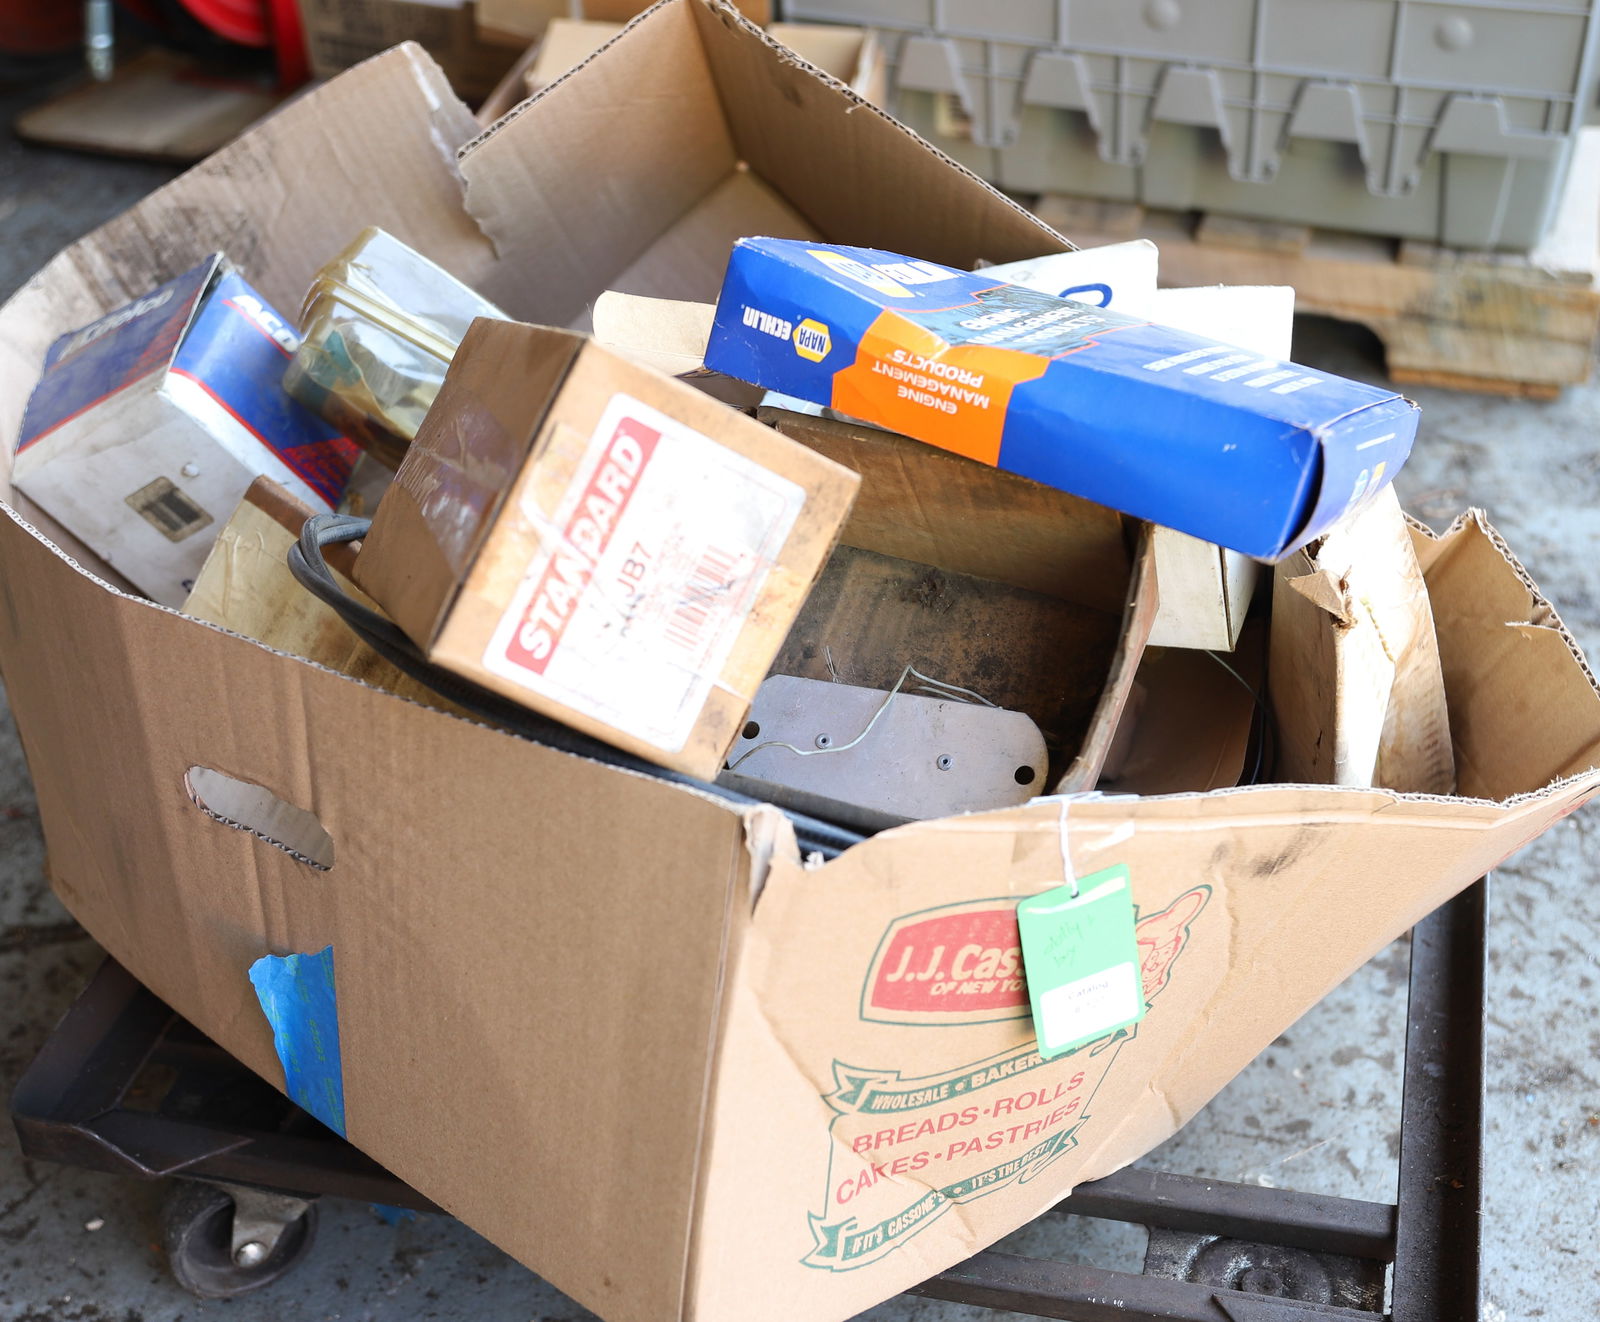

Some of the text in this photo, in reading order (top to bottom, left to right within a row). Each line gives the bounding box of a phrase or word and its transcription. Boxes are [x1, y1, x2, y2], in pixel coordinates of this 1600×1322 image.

[743, 306, 827, 353] NAPA ECHLIN
[871, 361, 990, 409] MANAGEMENT
[893, 349, 984, 388] PRODUCTS
[897, 385, 958, 414] ENGINE
[519, 434, 643, 660] STANDARD
[617, 541, 652, 598] JB7
[886, 943, 1026, 982] J.J. Cas
[930, 977, 1027, 996] OF NEW YO
[872, 1053, 1053, 1111] WHOLESALE BAKER
[852, 1071, 1085, 1153] BREADS ROLLS
[836, 1096, 1081, 1205] CAKES PASTRIES
[888, 1191, 946, 1236] CASSONE'S
[997, 1159, 1021, 1180] THE
